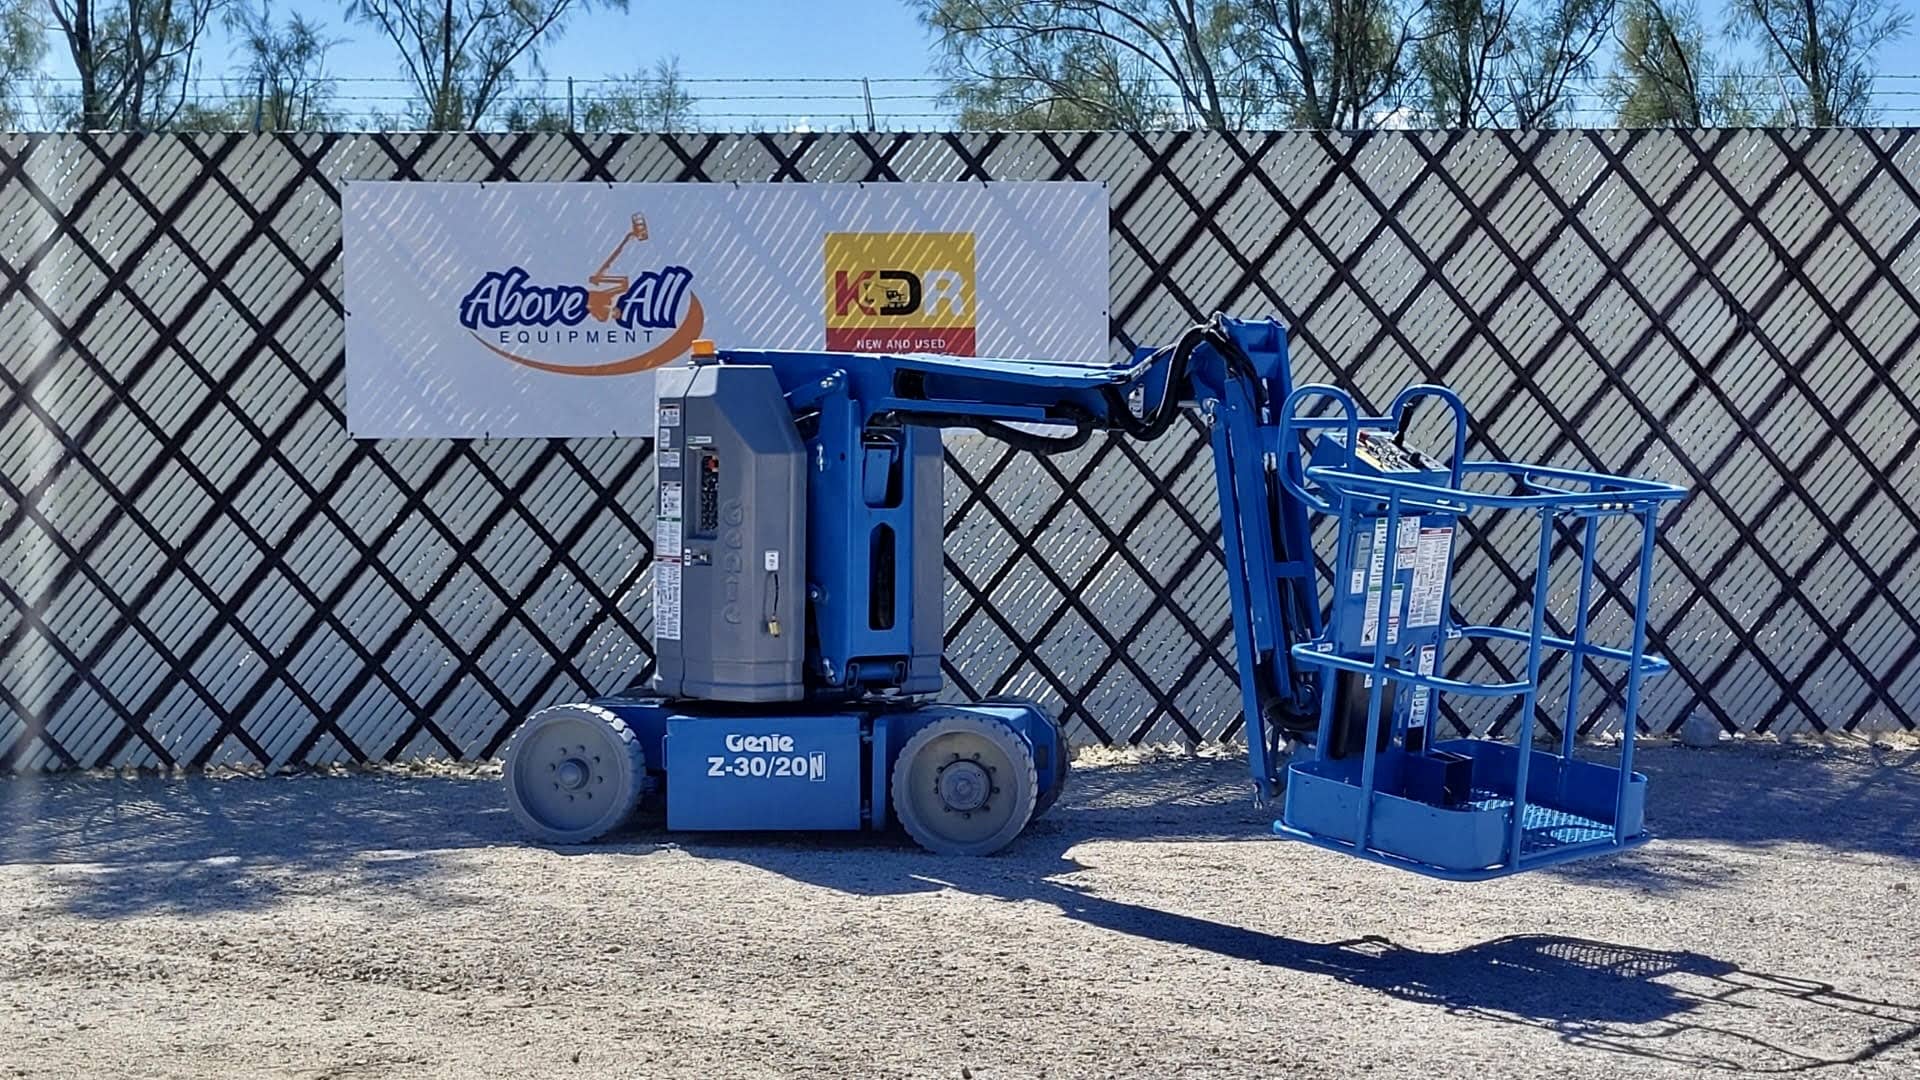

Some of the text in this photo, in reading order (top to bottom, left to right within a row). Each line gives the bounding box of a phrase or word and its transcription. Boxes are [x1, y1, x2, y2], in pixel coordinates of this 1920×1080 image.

[459, 265, 694, 330] Above All
[835, 269, 966, 317] KDR
[500, 331, 654, 344] EQUIPMENT
[856, 339, 946, 349] NEW AND USED
[725, 734, 795, 752] Genie
